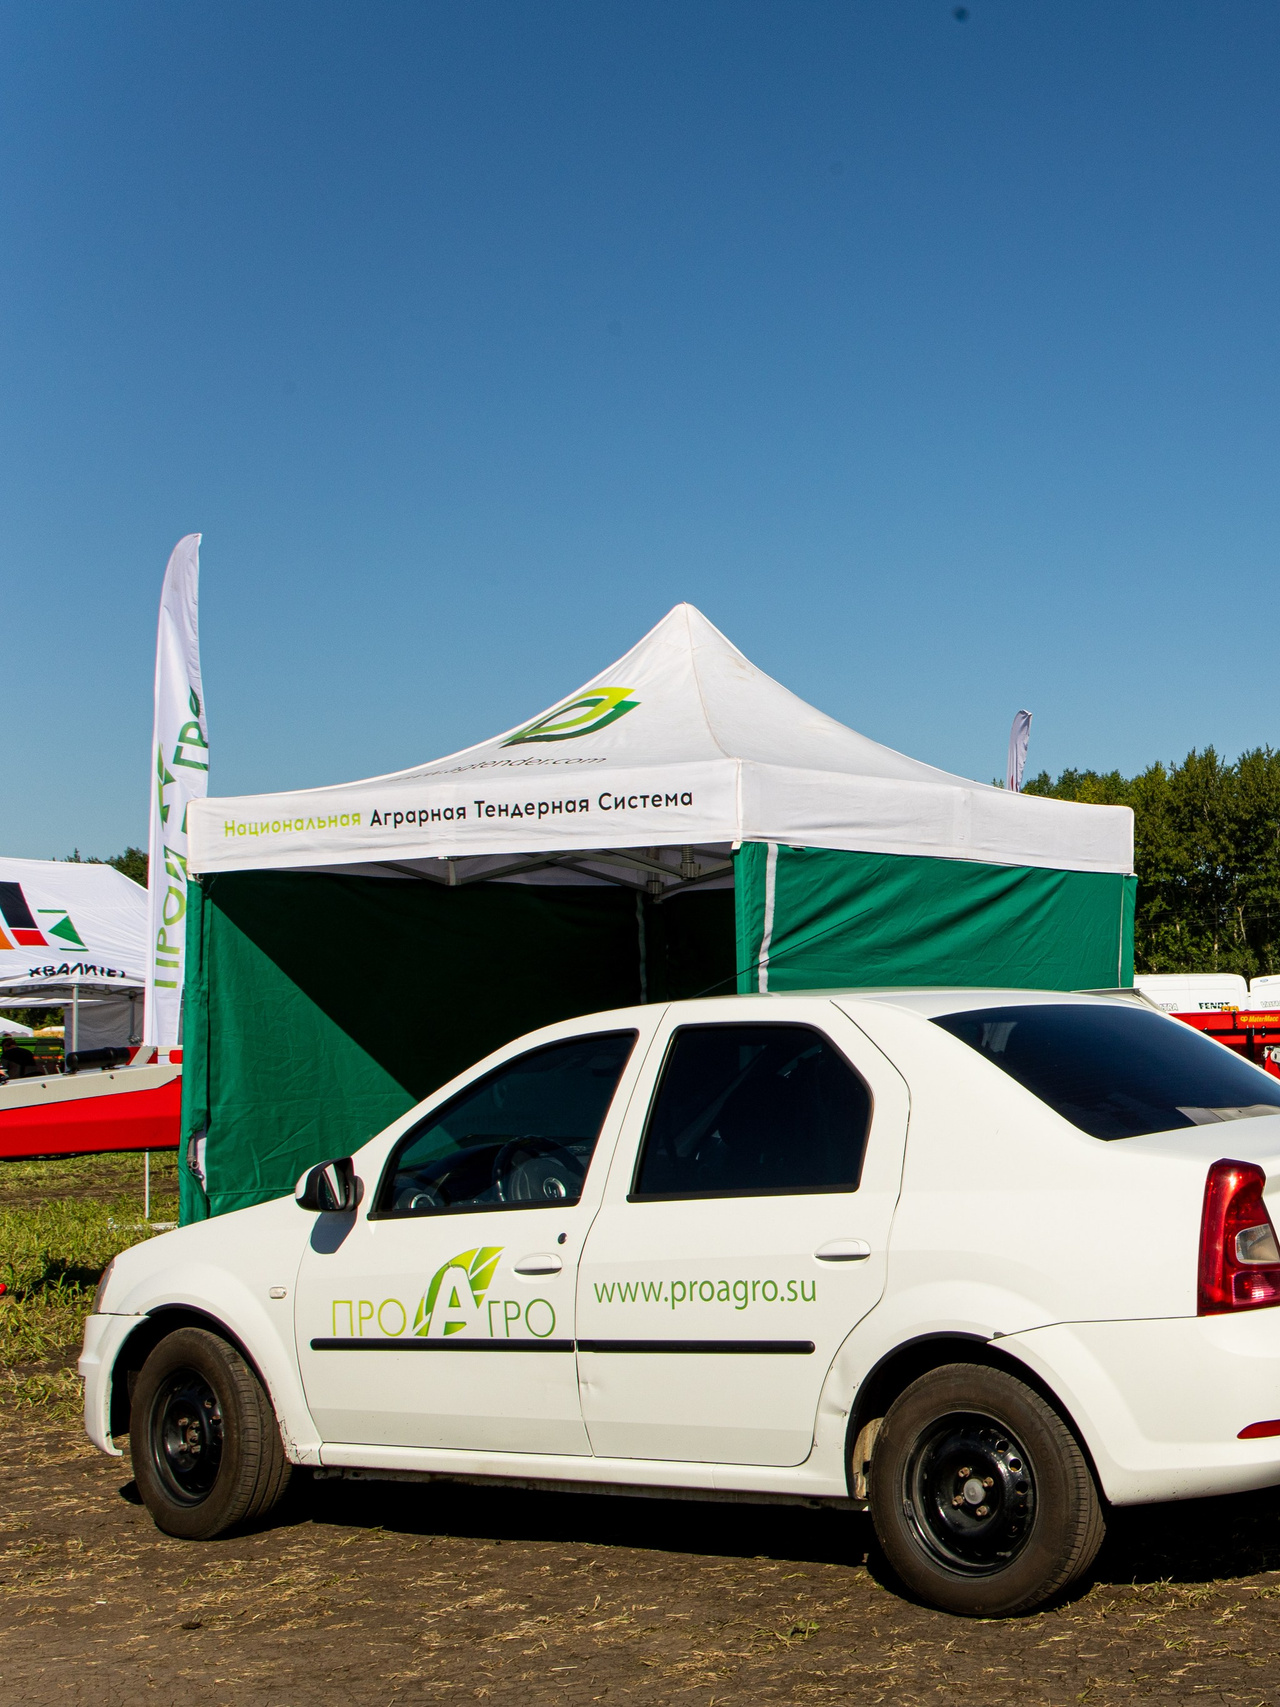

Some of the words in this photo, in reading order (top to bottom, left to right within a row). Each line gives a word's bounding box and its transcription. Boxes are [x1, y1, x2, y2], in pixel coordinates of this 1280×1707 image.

[224, 811, 362, 838] Национальная
[369, 806, 467, 830] Аграрная
[473, 798, 590, 821] Тендерная
[597, 789, 693, 812] Система
[593, 1276, 817, 1310] www.proagro.su
